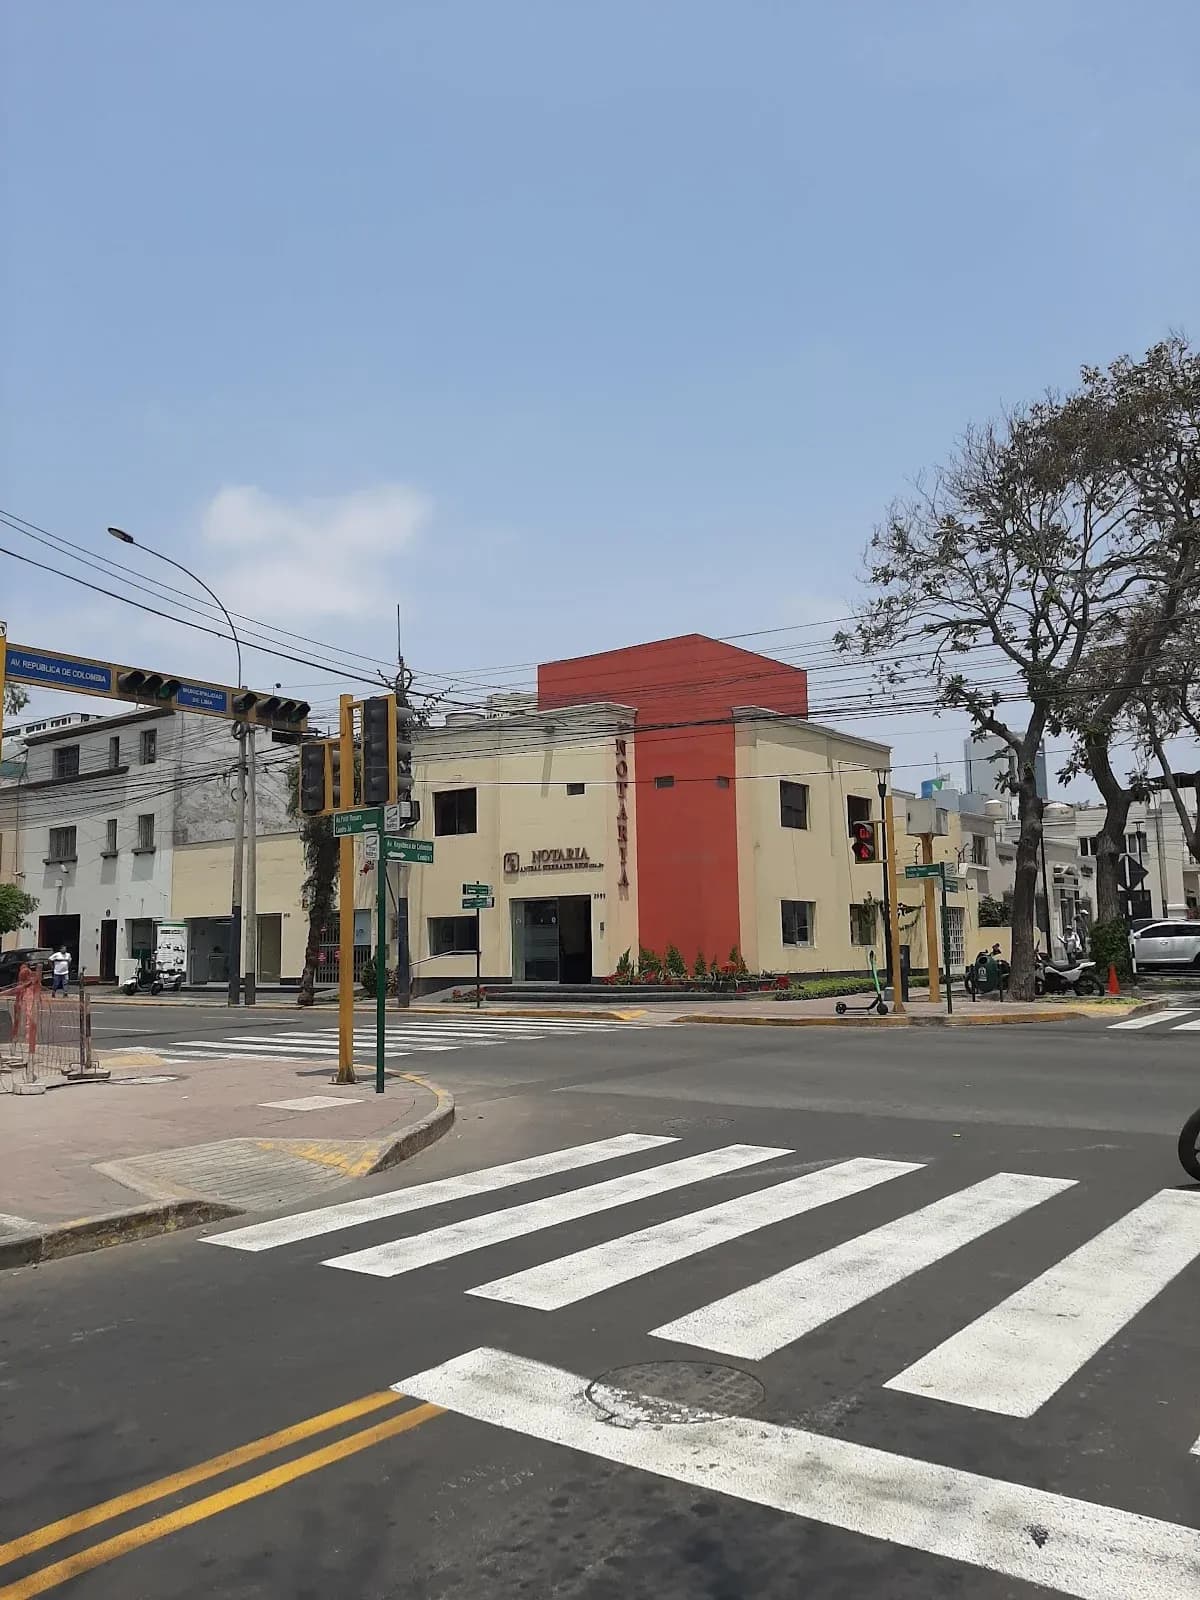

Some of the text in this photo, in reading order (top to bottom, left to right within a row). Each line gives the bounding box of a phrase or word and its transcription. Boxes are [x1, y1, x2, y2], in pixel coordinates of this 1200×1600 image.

[10, 658, 21, 668] AV.
[61, 667, 71, 677] DE
[72, 669, 106, 683] COLOMBIA
[615, 739, 629, 886] NOTARIA
[531, 847, 590, 864] NOTARIA
